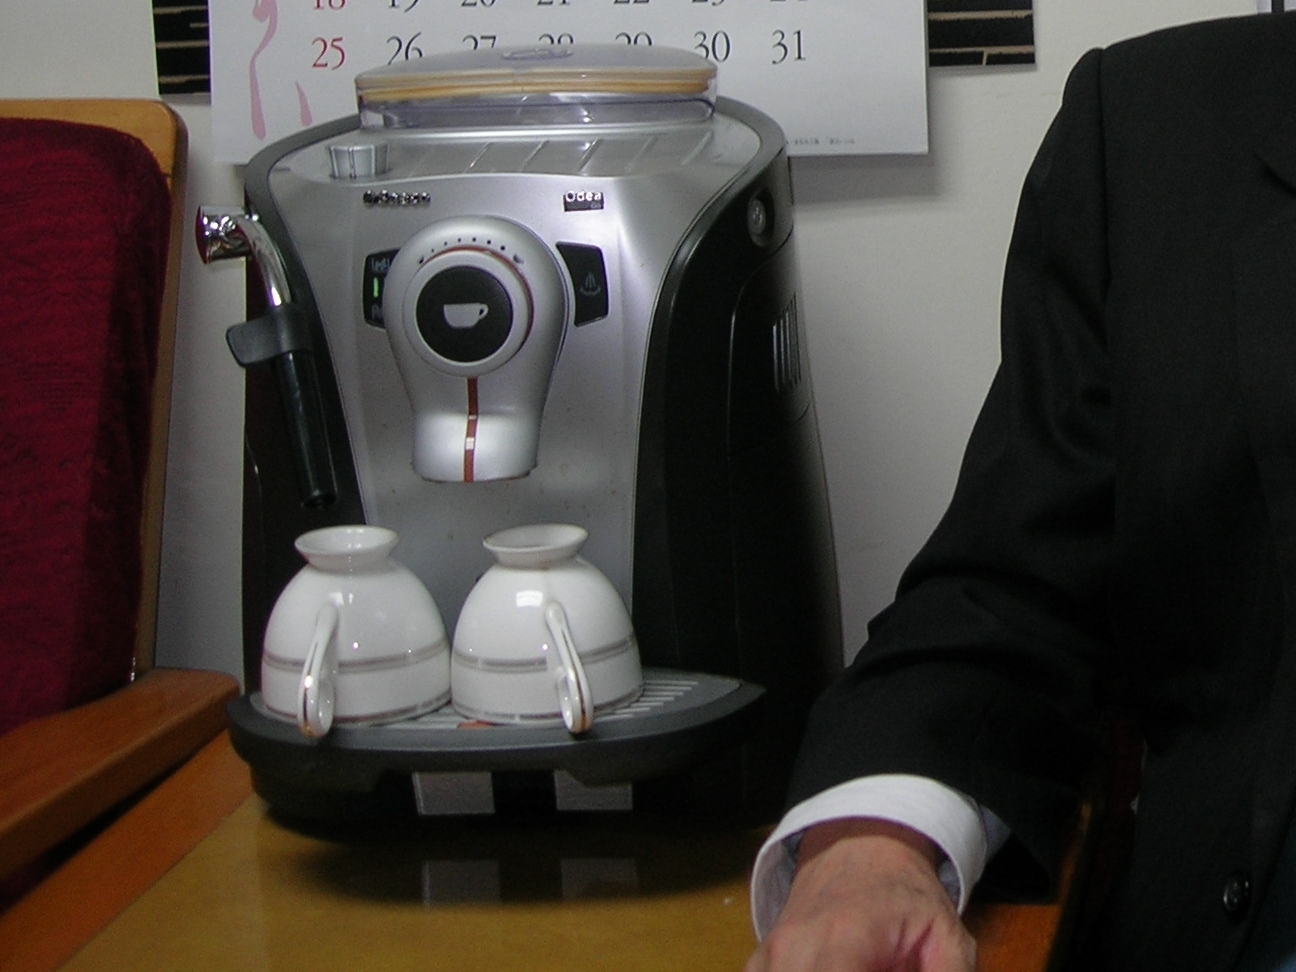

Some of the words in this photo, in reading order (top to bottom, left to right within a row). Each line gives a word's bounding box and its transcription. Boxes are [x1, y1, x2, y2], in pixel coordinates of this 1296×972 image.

[312, 37, 346, 69] 25
[385, 31, 424, 66] 26
[694, 31, 731, 65] 30
[772, 29, 805, 65] 31
